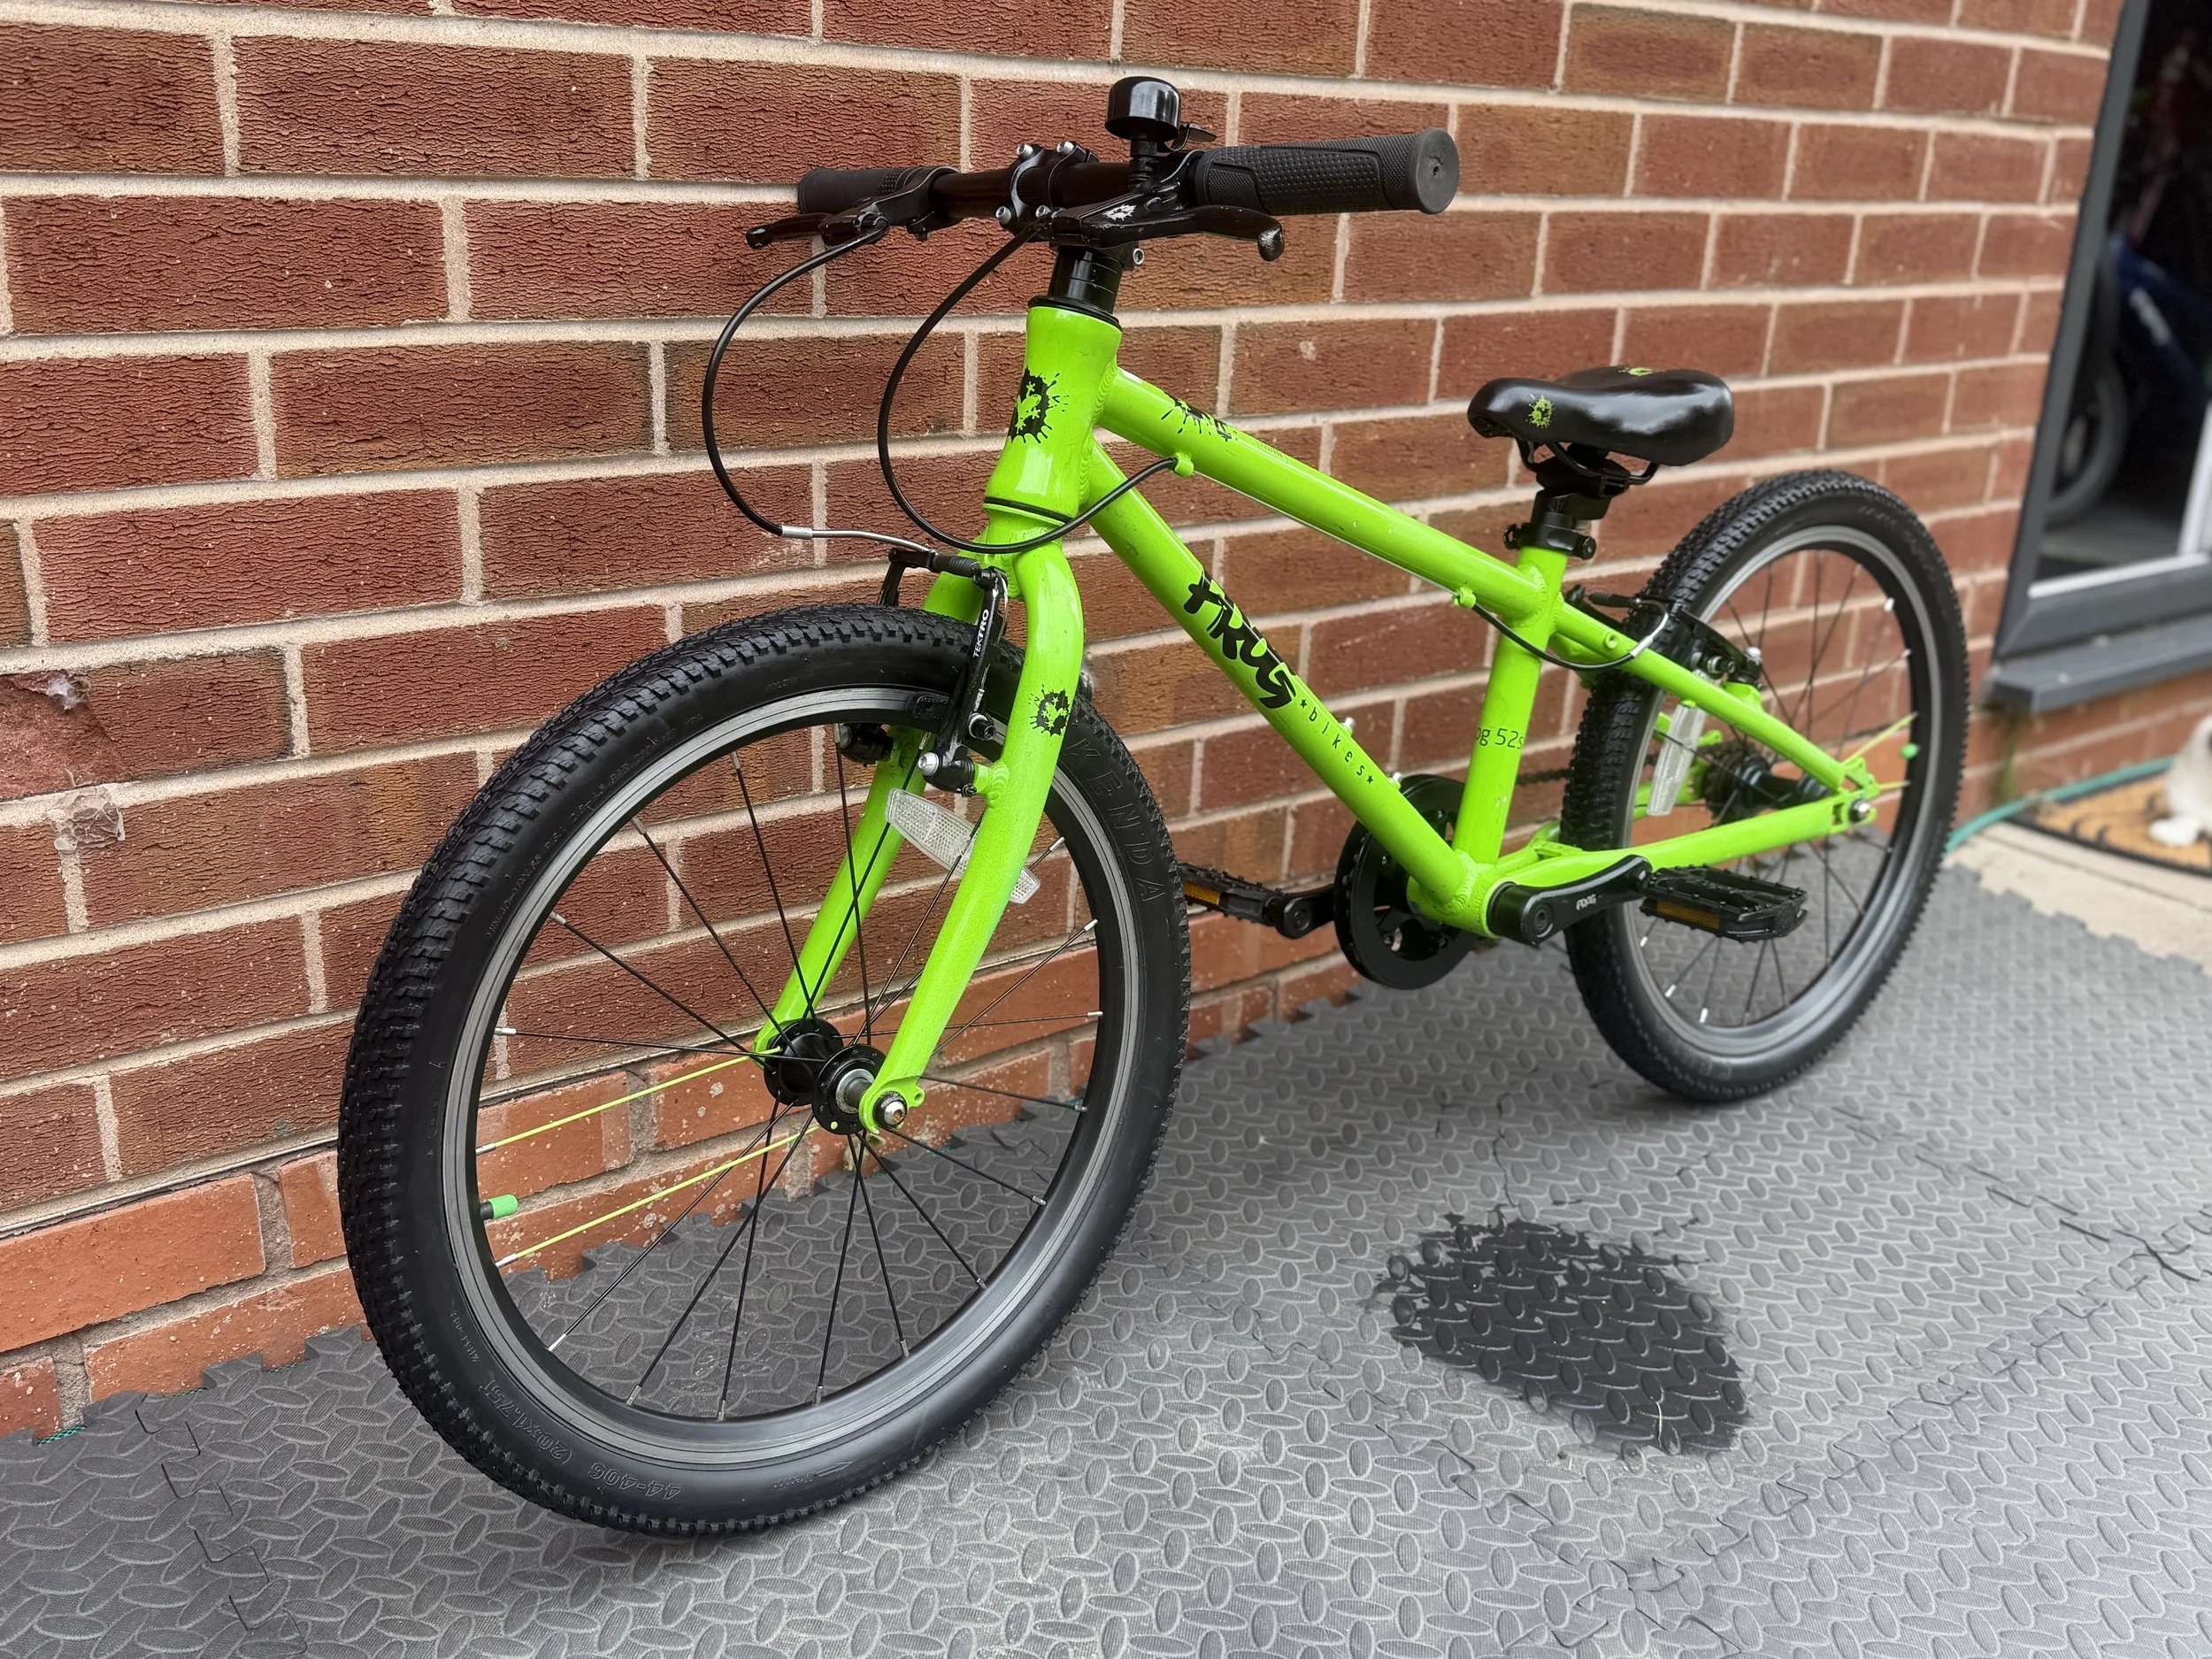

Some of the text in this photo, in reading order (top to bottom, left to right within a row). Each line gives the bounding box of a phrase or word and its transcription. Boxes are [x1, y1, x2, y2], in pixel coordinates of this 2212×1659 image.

[972, 609, 990, 658] TEKTRO
[1308, 707, 1364, 776] bikes
[1064, 737, 1166, 902] KENDA
[588, 1463, 682, 1501] 44-406
